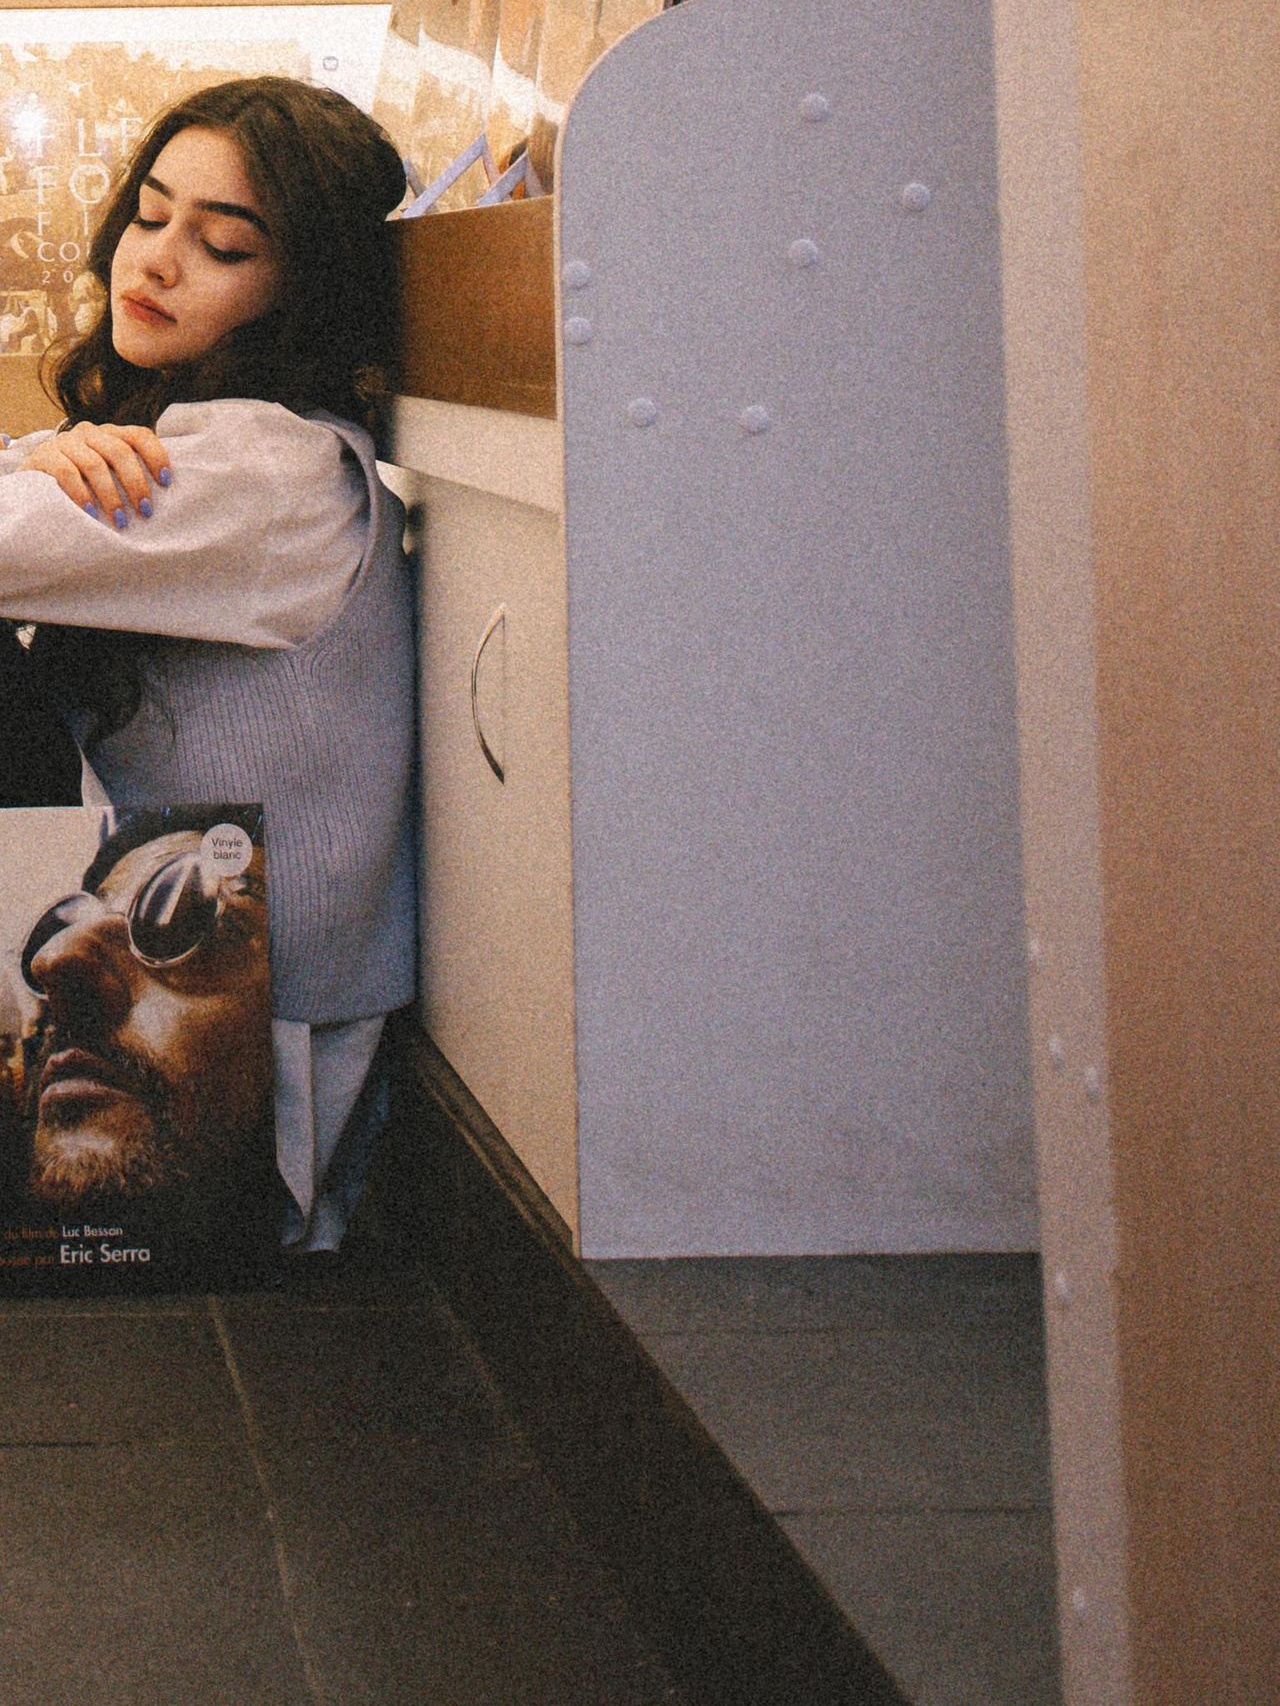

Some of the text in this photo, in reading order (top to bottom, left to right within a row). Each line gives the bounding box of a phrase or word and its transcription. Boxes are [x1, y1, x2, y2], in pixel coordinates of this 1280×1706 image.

[211, 837, 243, 849] Vinyle
[213, 850, 241, 860] blanc
[62, 1225, 80, 1238] Luc
[84, 1225, 124, 1237] Besson
[60, 1244, 93, 1264] Eric
[100, 1243, 150, 1263] Serra
